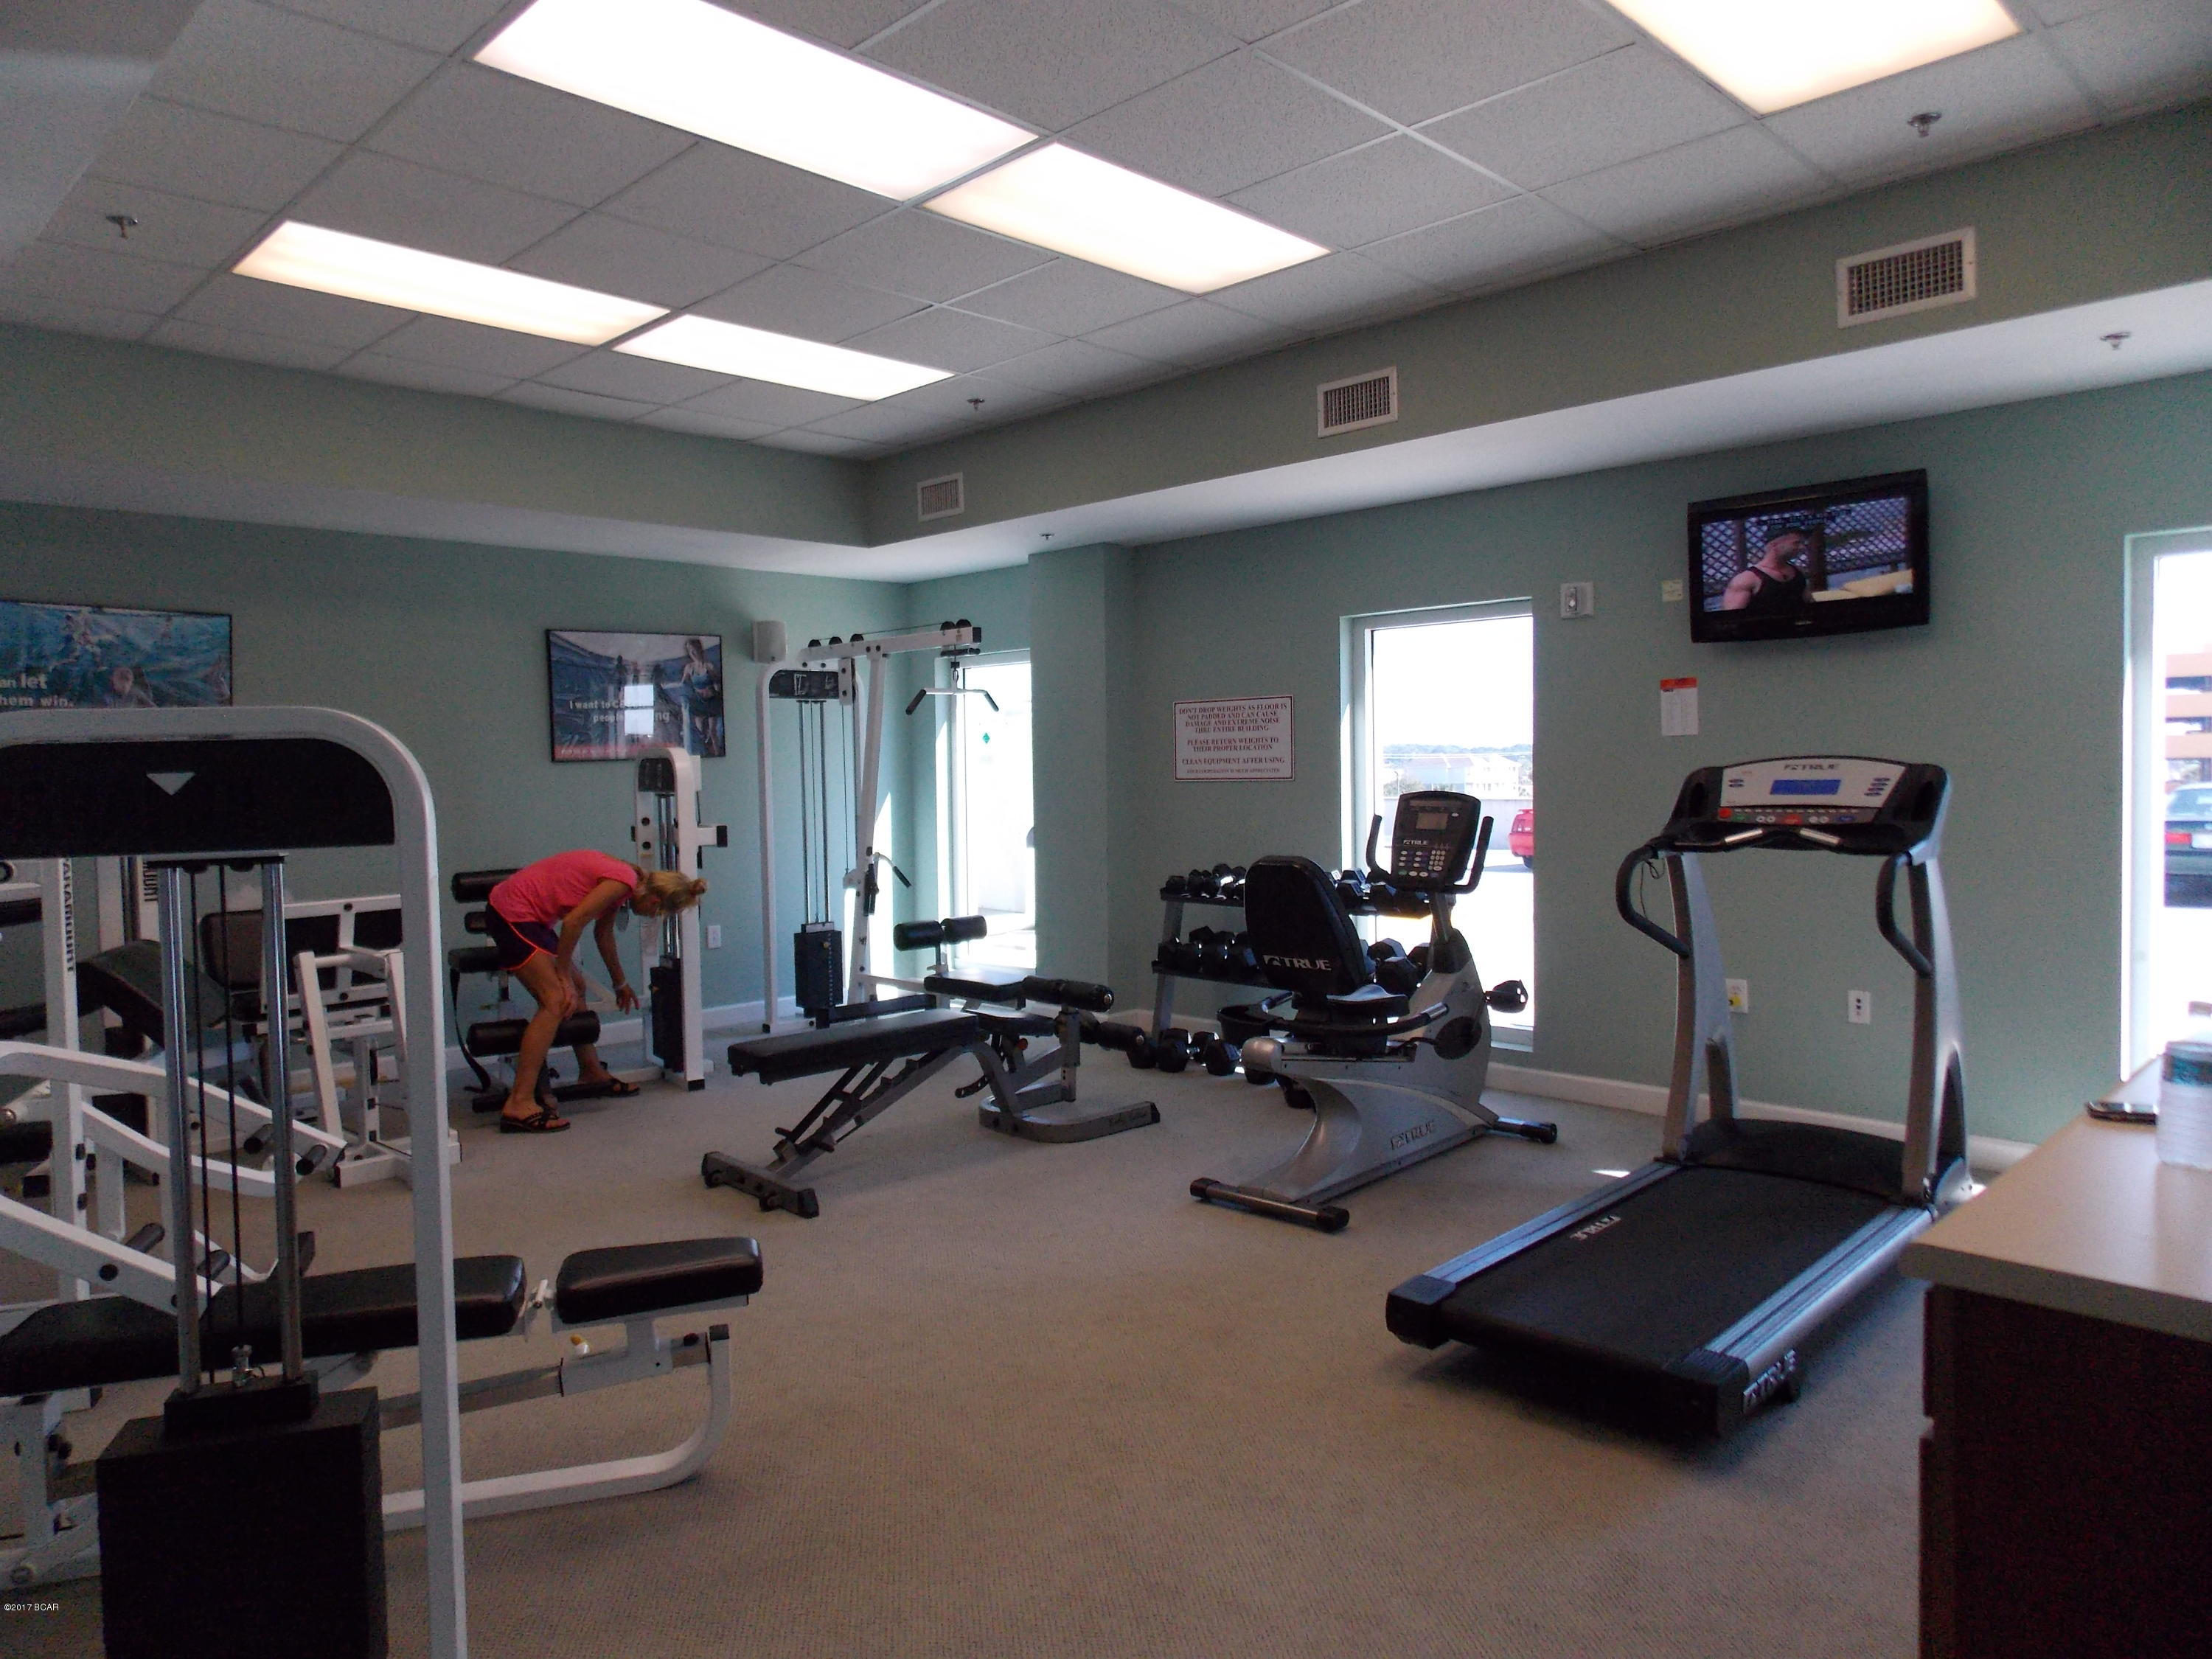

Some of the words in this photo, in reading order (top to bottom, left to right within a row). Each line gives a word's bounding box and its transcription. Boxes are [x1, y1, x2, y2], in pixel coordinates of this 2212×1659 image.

[20, 673, 48, 689] let
[0, 695, 34, 706] hem
[574, 700, 598, 709] want
[593, 713, 625, 724] peopl
[63, 858, 74, 972] ARAMOUNT
[1280, 957, 1332, 971] TRUE
